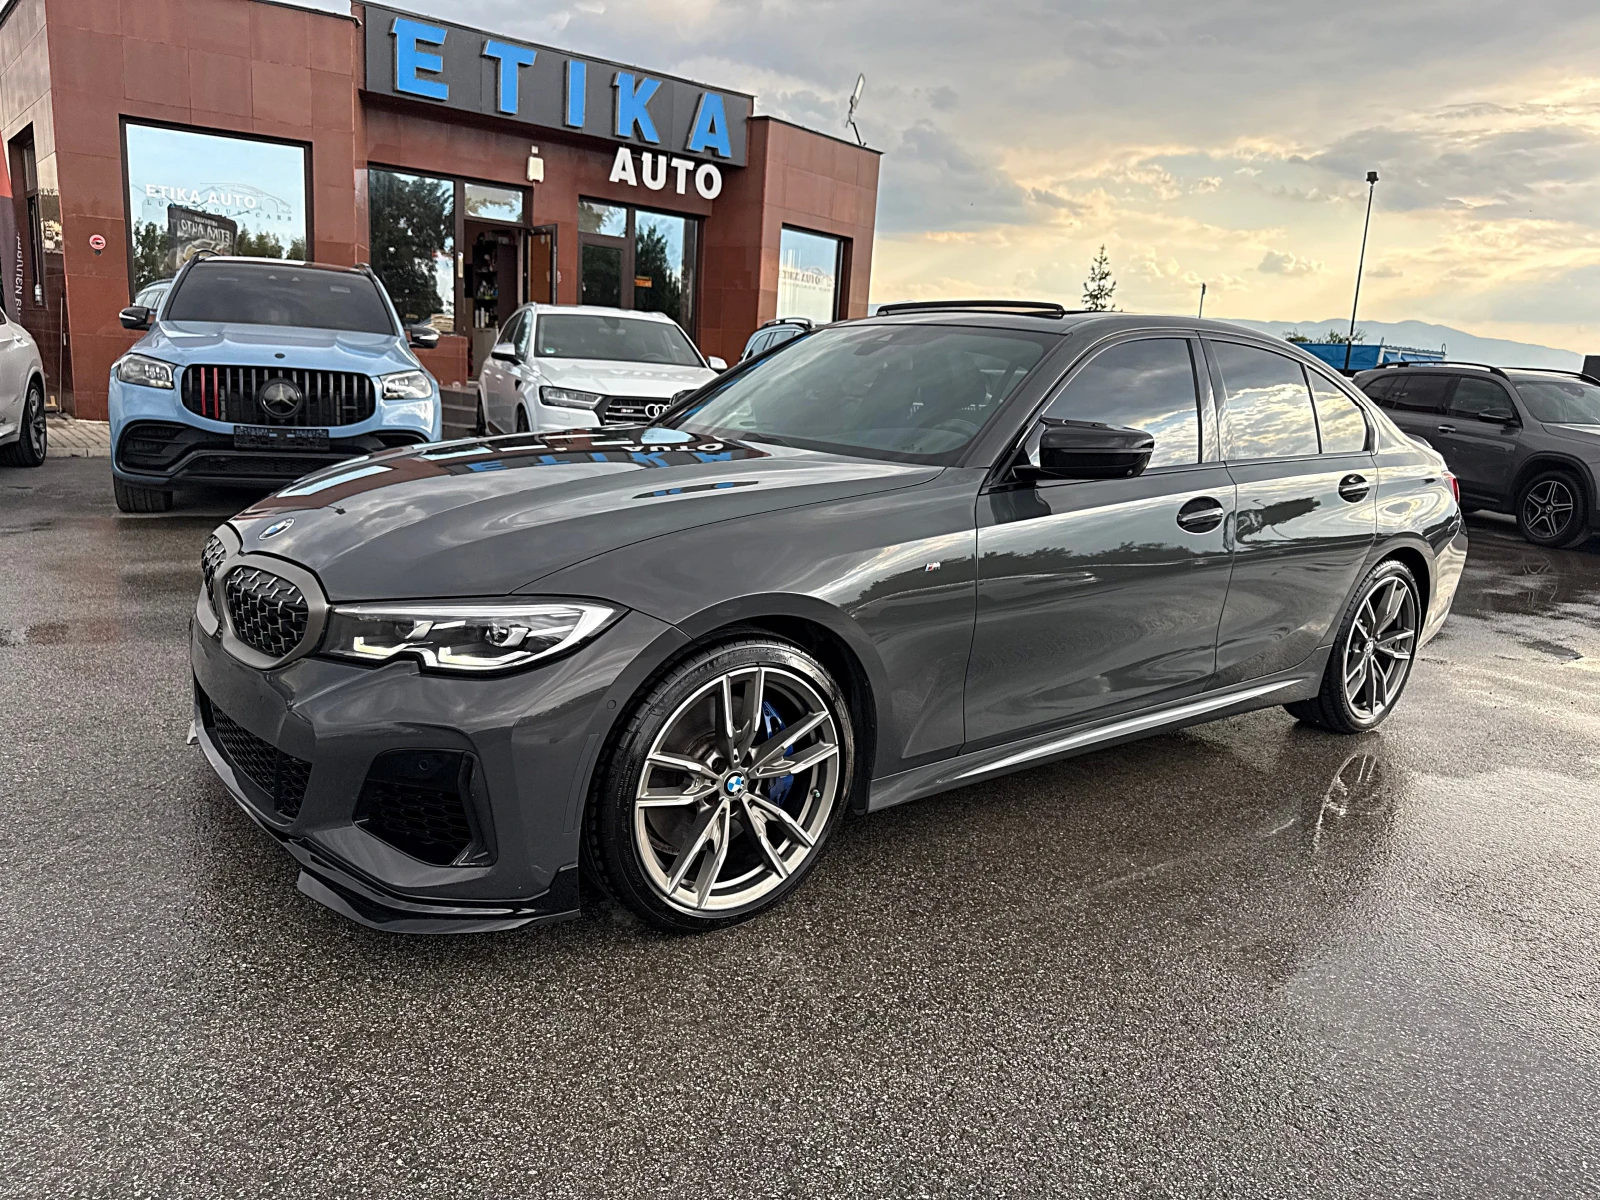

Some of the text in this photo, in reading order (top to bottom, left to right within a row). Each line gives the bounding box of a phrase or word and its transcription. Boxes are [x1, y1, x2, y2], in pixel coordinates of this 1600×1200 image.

[390, 17, 732, 158] ETIKA
[145, 184, 257, 209] ETIKA AUTO
[609, 147, 722, 200] AUTO
